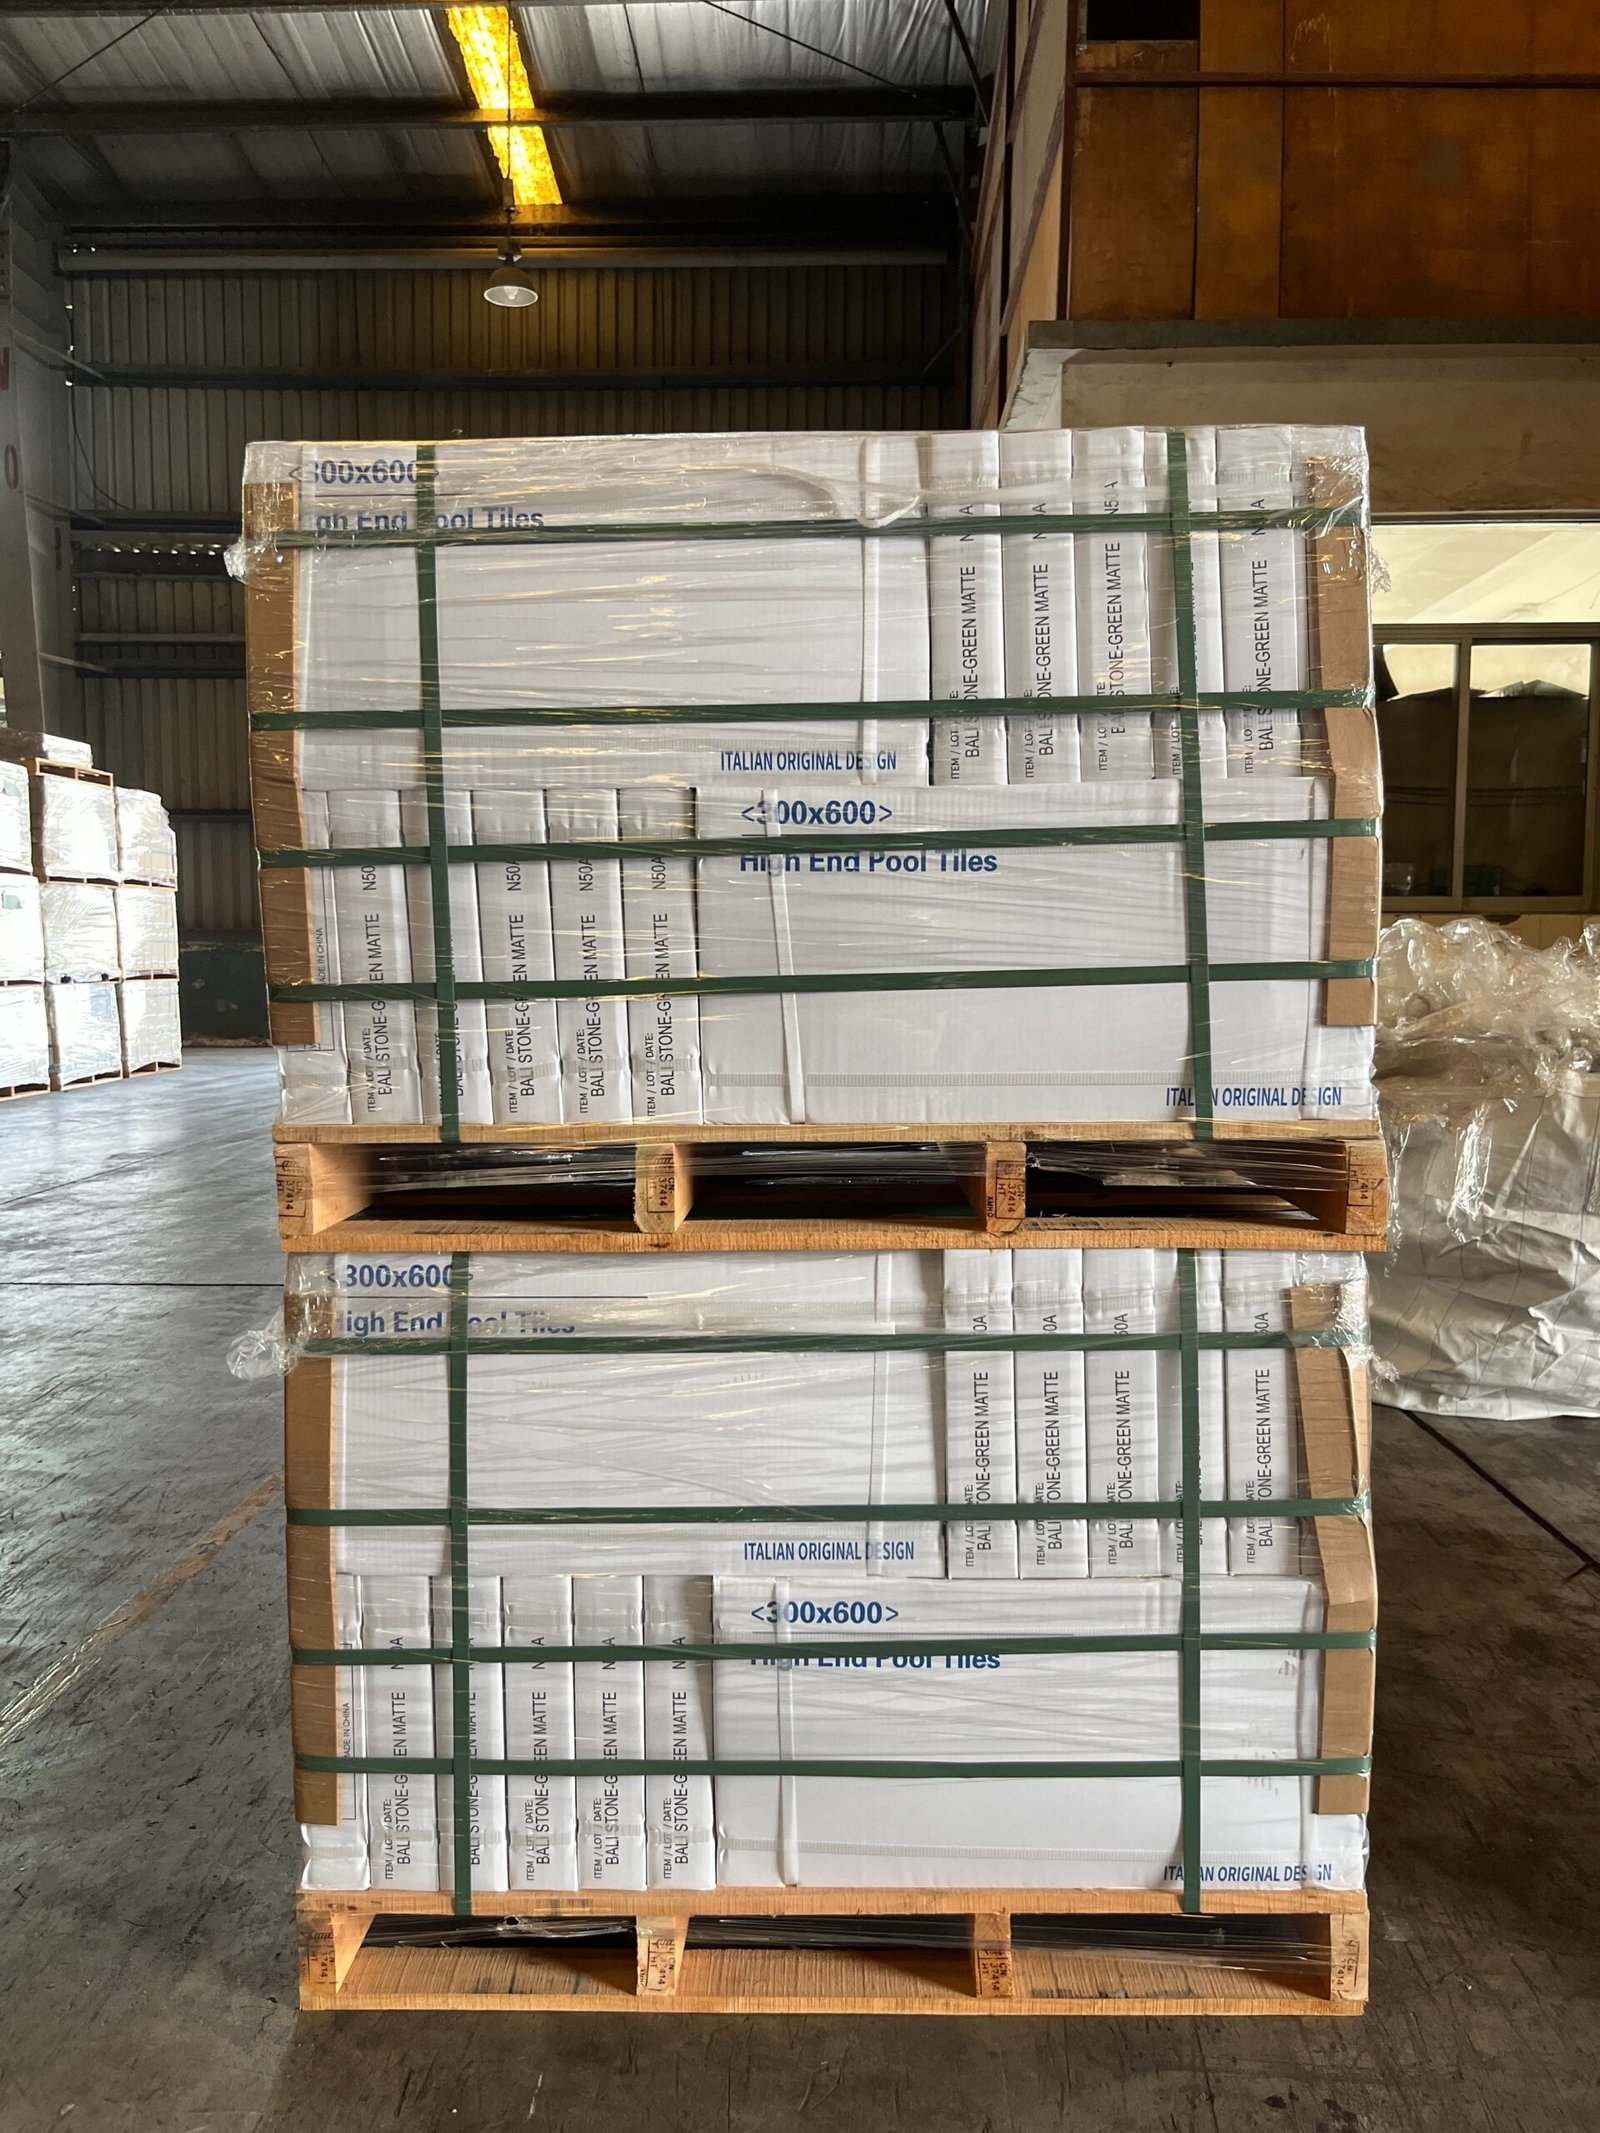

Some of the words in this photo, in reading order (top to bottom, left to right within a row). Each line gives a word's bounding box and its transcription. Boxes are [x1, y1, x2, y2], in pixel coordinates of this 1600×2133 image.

[482, 506, 544, 528] Tiles
[1105, 542, 1121, 590] MATTE
[960, 566, 976, 613] MATTE
[1033, 564, 1049, 611] MATTE
[1252, 560, 1269, 608] MATTE
[950, 730, 960, 747] LOT
[720, 752, 772, 770] ITALIAN
[777, 751, 842, 770] ORIGINAL
[950, 758, 960, 779] ITEM
[1025, 756, 1034, 778] ITEM
[1098, 750, 1108, 771] ITEM
[1172, 754, 1181, 775] ITEM
[1244, 752, 1254, 774] ITEM
[651, 856, 666, 890] N50A
[810, 853, 860, 873] End
[869, 851, 927, 872] Pool
[937, 848, 998, 872] Tiles
[315, 928, 324, 954] CHINA
[365, 914, 382, 958] MATTE
[509, 914, 526, 960] MATTE
[581, 914, 597, 960] MATTE
[653, 914, 669, 958] MATTE
[584, 964, 603, 1064] STONE-GEN
[362, 1028, 372, 1052] DATE:
[576, 1030, 586, 1054] DATE:
[644, 1033, 654, 1058] DATE:
[508, 1066, 516, 1082] LOT
[520, 1067, 534, 1096] BALI
[646, 1070, 655, 1086] LOT
[660, 1066, 675, 1096] BALI
[367, 1092, 376, 1112] ITEM
[509, 1092, 518, 1113] ITEM
[580, 1092, 588, 1114] ITEM
[647, 1096, 656, 1117] ITEM
[1166, 1088, 1218, 1106] ITALN
[1222, 1088, 1288, 1106] ORIGINAL
[659, 1178, 667, 1206] 37414
[998, 1184, 1006, 1196] HT
[1008, 1184, 1016, 1212] 37414
[974, 1372, 989, 1416] MATTE
[1044, 1371, 1059, 1416] MATTE
[1115, 1370, 1130, 1415] MATTE
[1255, 1369, 1270, 1414] MATTE
[1036, 1520, 1044, 1536] LOT
[1048, 1521, 1062, 1550] BALI
[744, 1542, 794, 1560] ITALIAN
[800, 1542, 862, 1560] ORIGINAL
[965, 1547, 974, 1567] ITEM
[1036, 1546, 1045, 1566] ITEM
[1108, 1544, 1116, 1564] ITEM
[1246, 1543, 1256, 1564] ITEM
[531, 1637, 546, 1670] NA
[602, 1637, 616, 1670] NA
[672, 1637, 686, 1670] NA
[342, 1702, 350, 1727] CHINA
[391, 1692, 407, 1734] MATTE
[532, 1692, 547, 1734] MATTE
[602, 1692, 617, 1734] MATTE
[672, 1692, 686, 1734] MATTE
[393, 1739, 410, 1832] STONE-GEN
[534, 1738, 550, 1832] STONE-GEEN
[604, 1738, 618, 1832] STONE-GEEN
[674, 1738, 688, 1832] STONE-GEEN
[383, 1799, 392, 1822] DATE:
[525, 1800, 534, 1824] DATE:
[593, 1798, 602, 1822] DATE:
[663, 1798, 672, 1822] DATE:
[526, 1834, 534, 1850] LOT
[536, 1836, 550, 1864] BALI
[605, 1836, 619, 1864] BALI
[384, 1860, 394, 1880] ITEM
[526, 1860, 535, 1881] ITEM
[594, 1860, 602, 1879] ITEM
[664, 1859, 672, 1879] ITEM
[1218, 1866, 1280, 1882] ORIGINAL
[990, 1962, 1000, 1991] 37414
